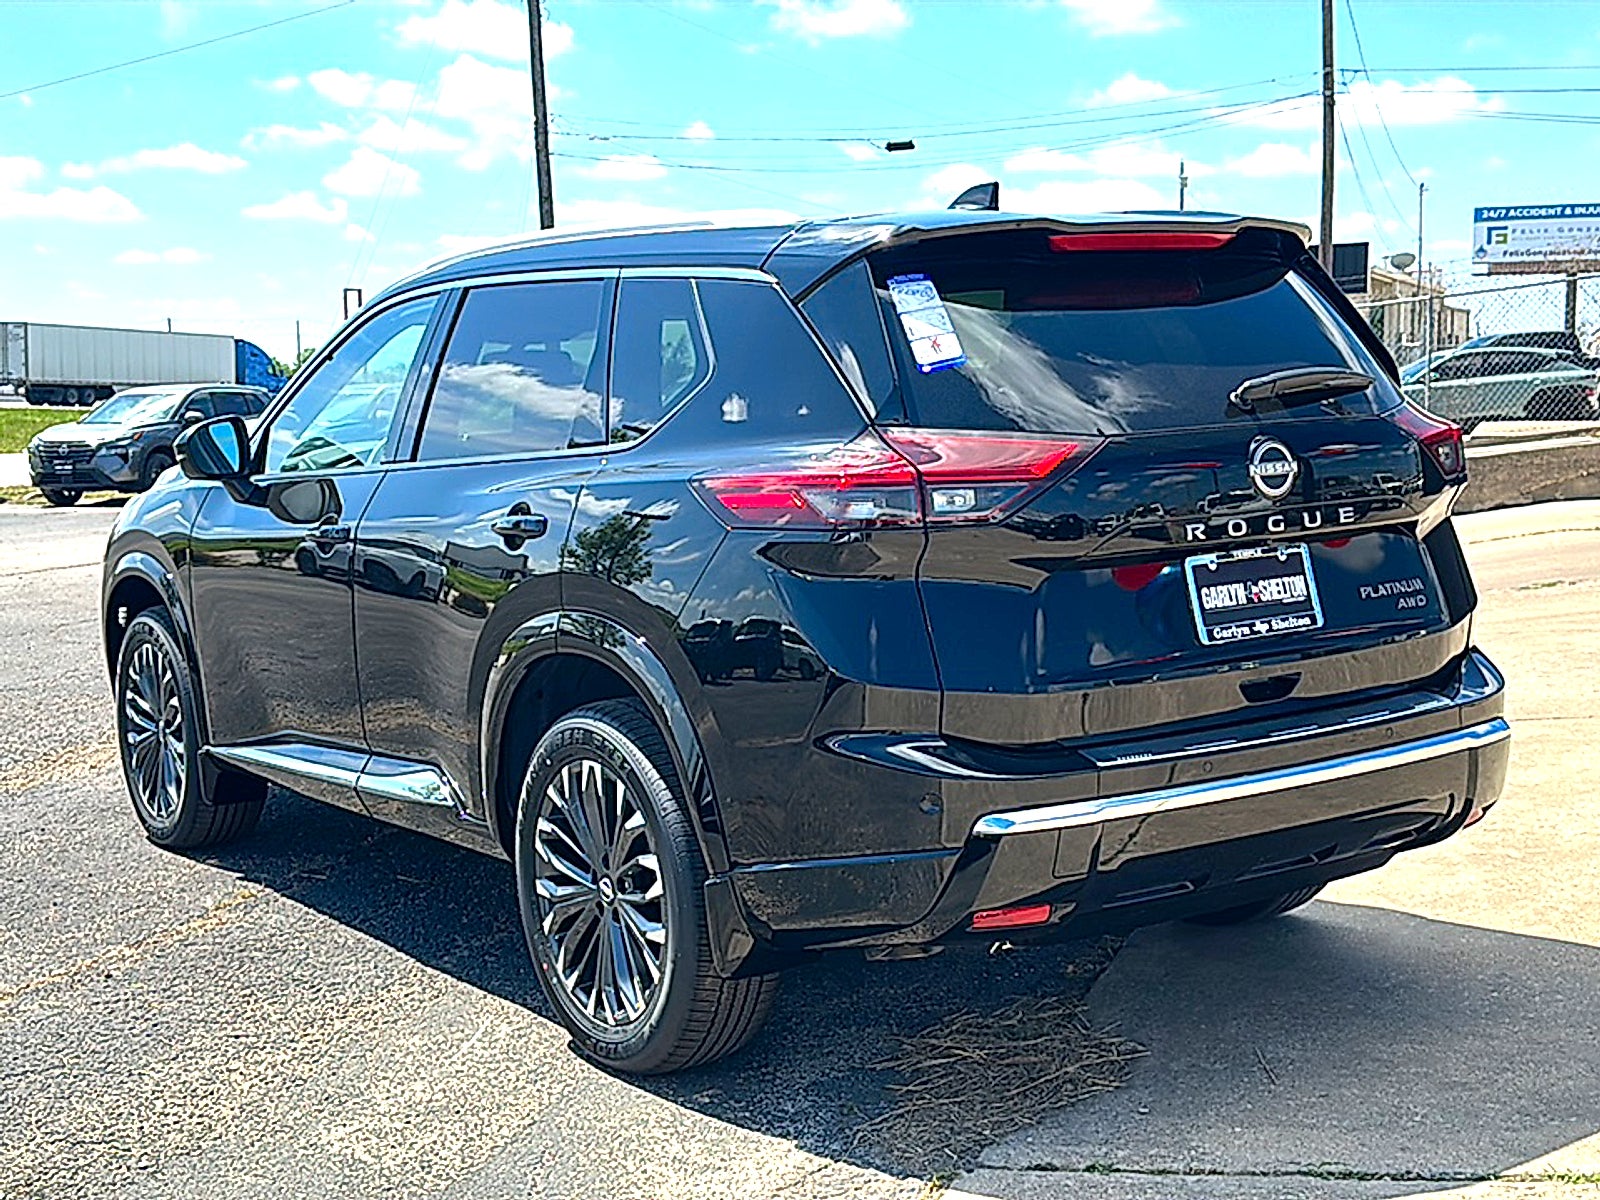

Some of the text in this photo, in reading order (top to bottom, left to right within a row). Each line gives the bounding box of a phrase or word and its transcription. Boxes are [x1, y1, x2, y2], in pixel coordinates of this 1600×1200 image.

[1481, 209, 1506, 219] 24/7
[1508, 206, 1562, 217] ACCIDENT
[1564, 206, 1572, 215] &
[1249, 460, 1298, 477] NISSAN
[1185, 506, 1356, 541] ROGUE
[1201, 574, 1308, 609] GARLYN SHELTON
[1360, 577, 1425, 600] PLATINUM
[1397, 594, 1427, 610] AWD
[1270, 617, 1312, 631] Shelton
